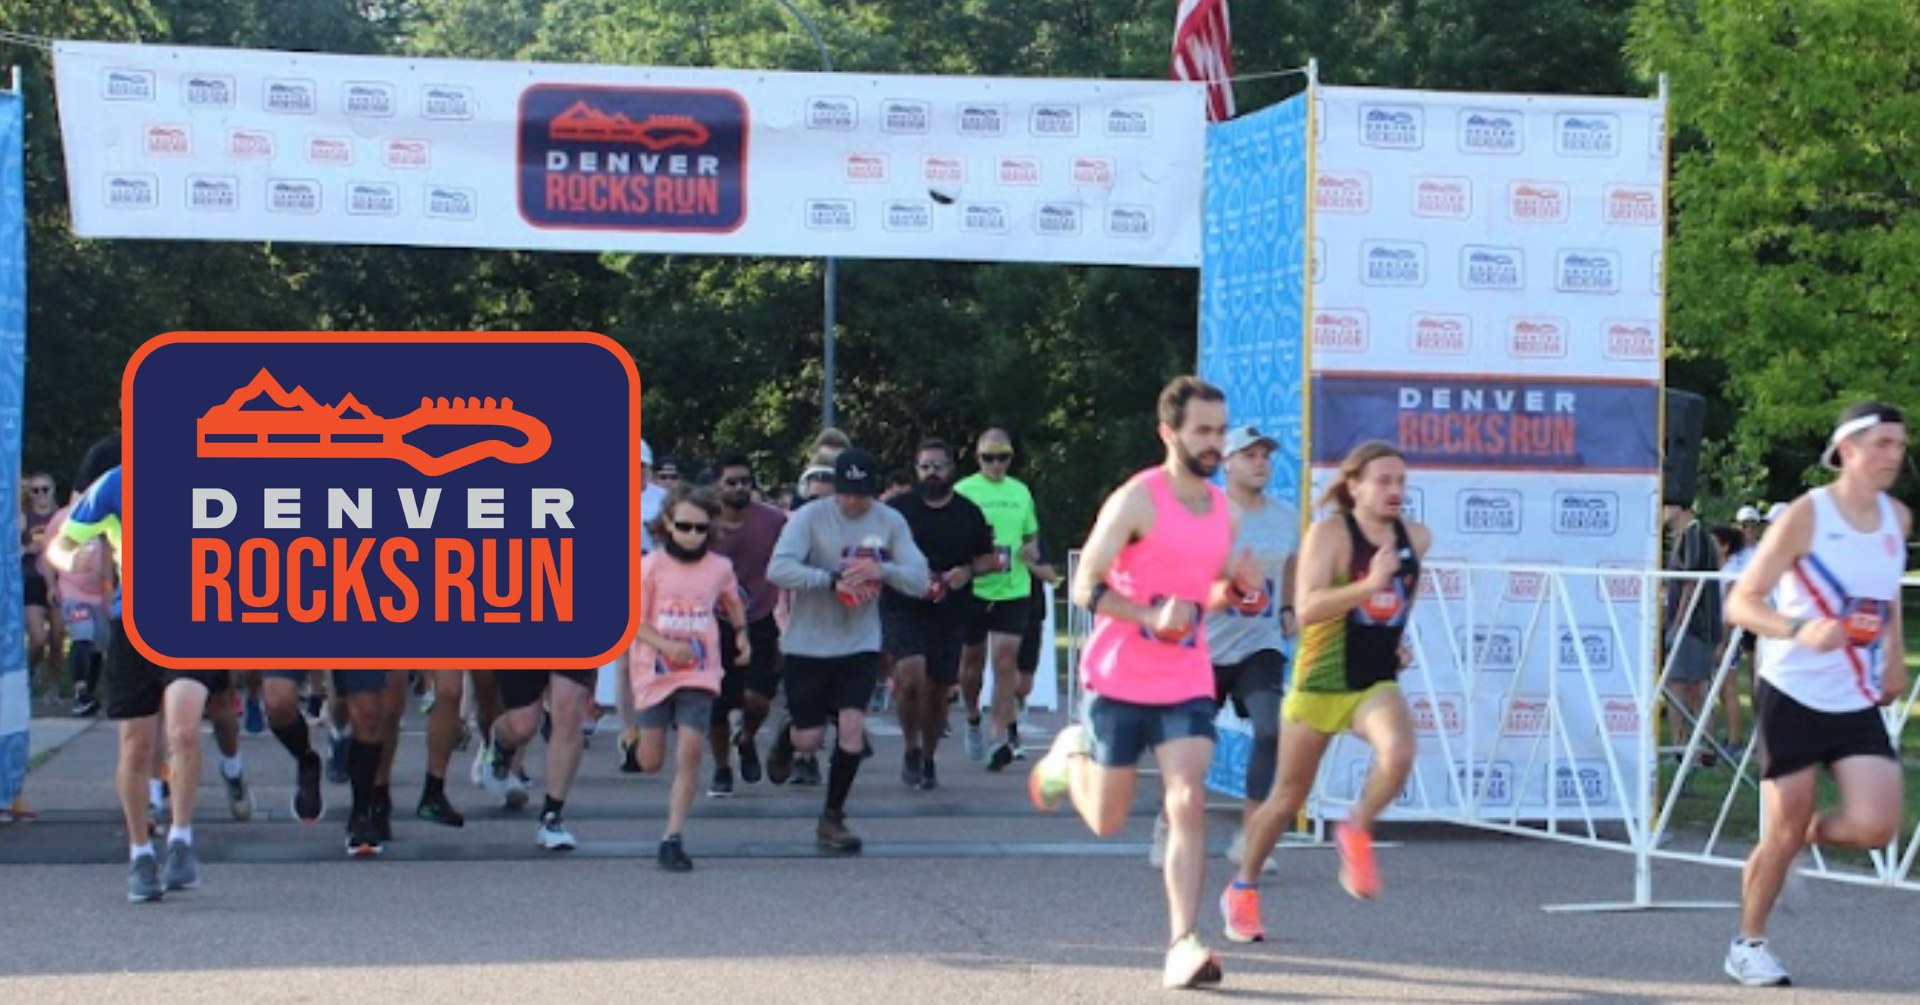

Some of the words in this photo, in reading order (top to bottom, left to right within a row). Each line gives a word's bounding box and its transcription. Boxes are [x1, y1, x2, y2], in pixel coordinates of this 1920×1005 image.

[547, 152, 718, 174] DENVER
[547, 175, 649, 213] ROCKS
[656, 177, 718, 214] RUN
[1399, 388, 1575, 411] DENVER
[1399, 412, 1505, 453] ROCKS
[1512, 415, 1575, 455] RUN
